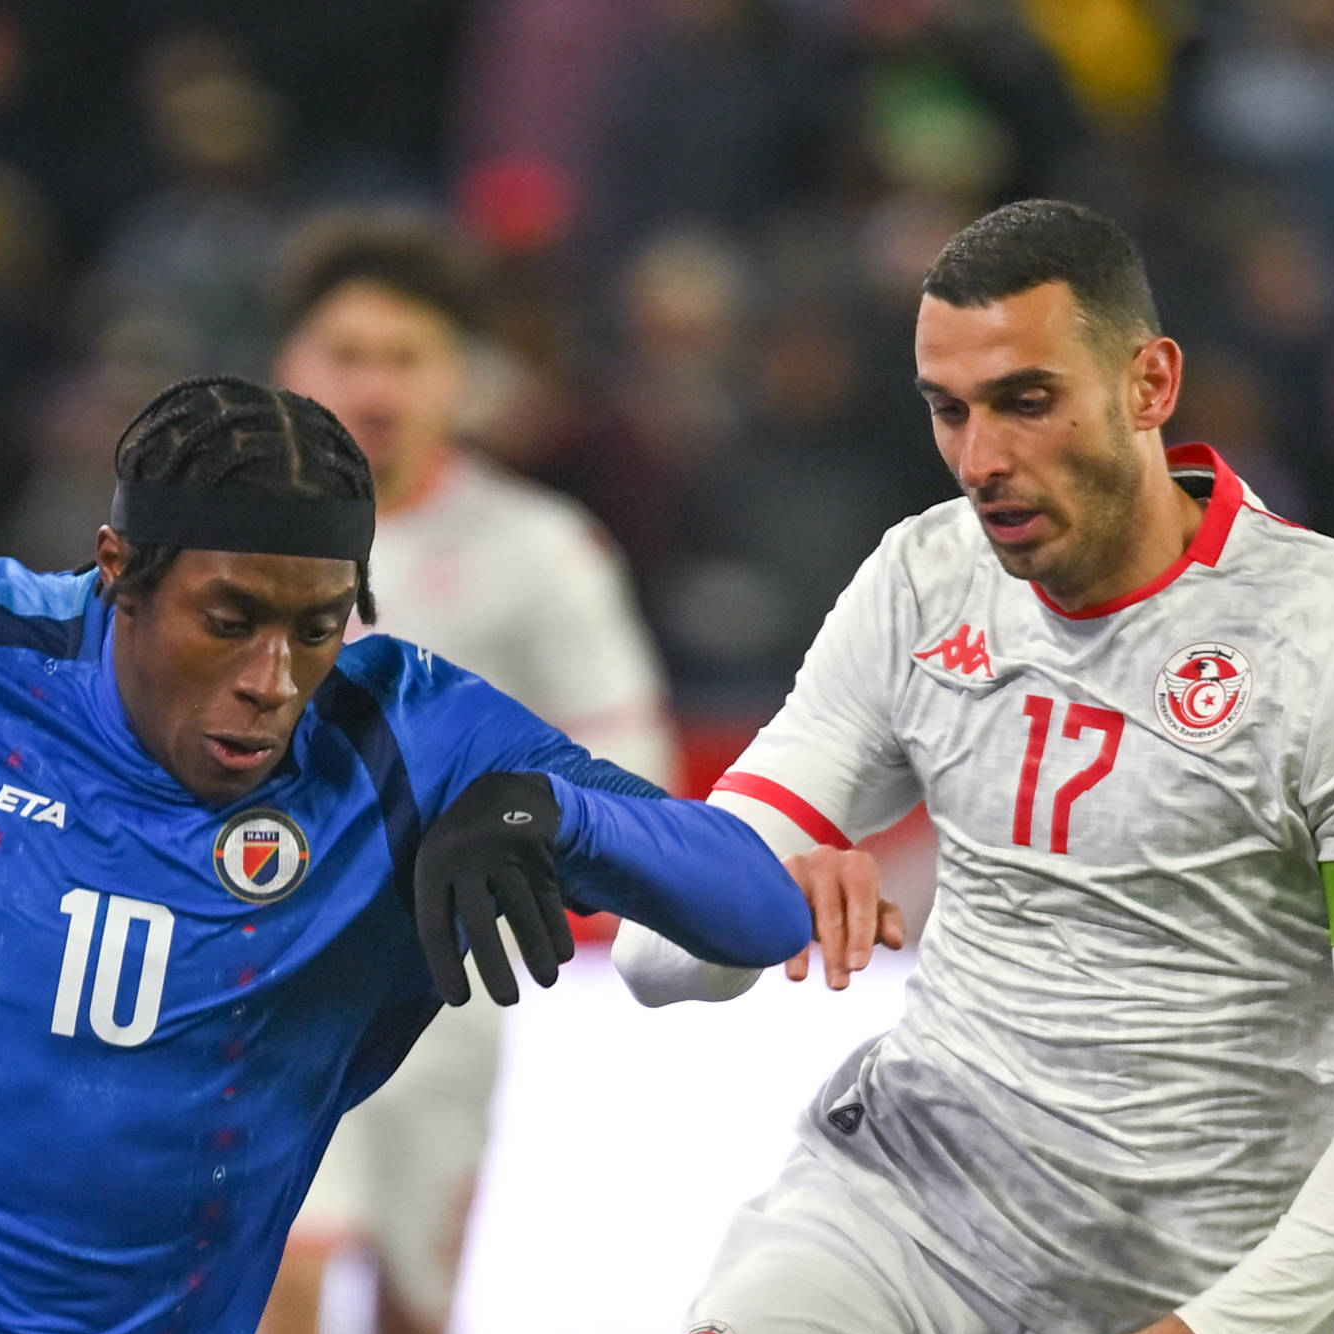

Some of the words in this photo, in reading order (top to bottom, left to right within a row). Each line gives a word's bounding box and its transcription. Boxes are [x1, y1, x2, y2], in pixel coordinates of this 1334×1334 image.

[247, 831, 276, 841] HAITI
[1012, 694, 1125, 855] 17
[51, 887, 175, 1048] 10
